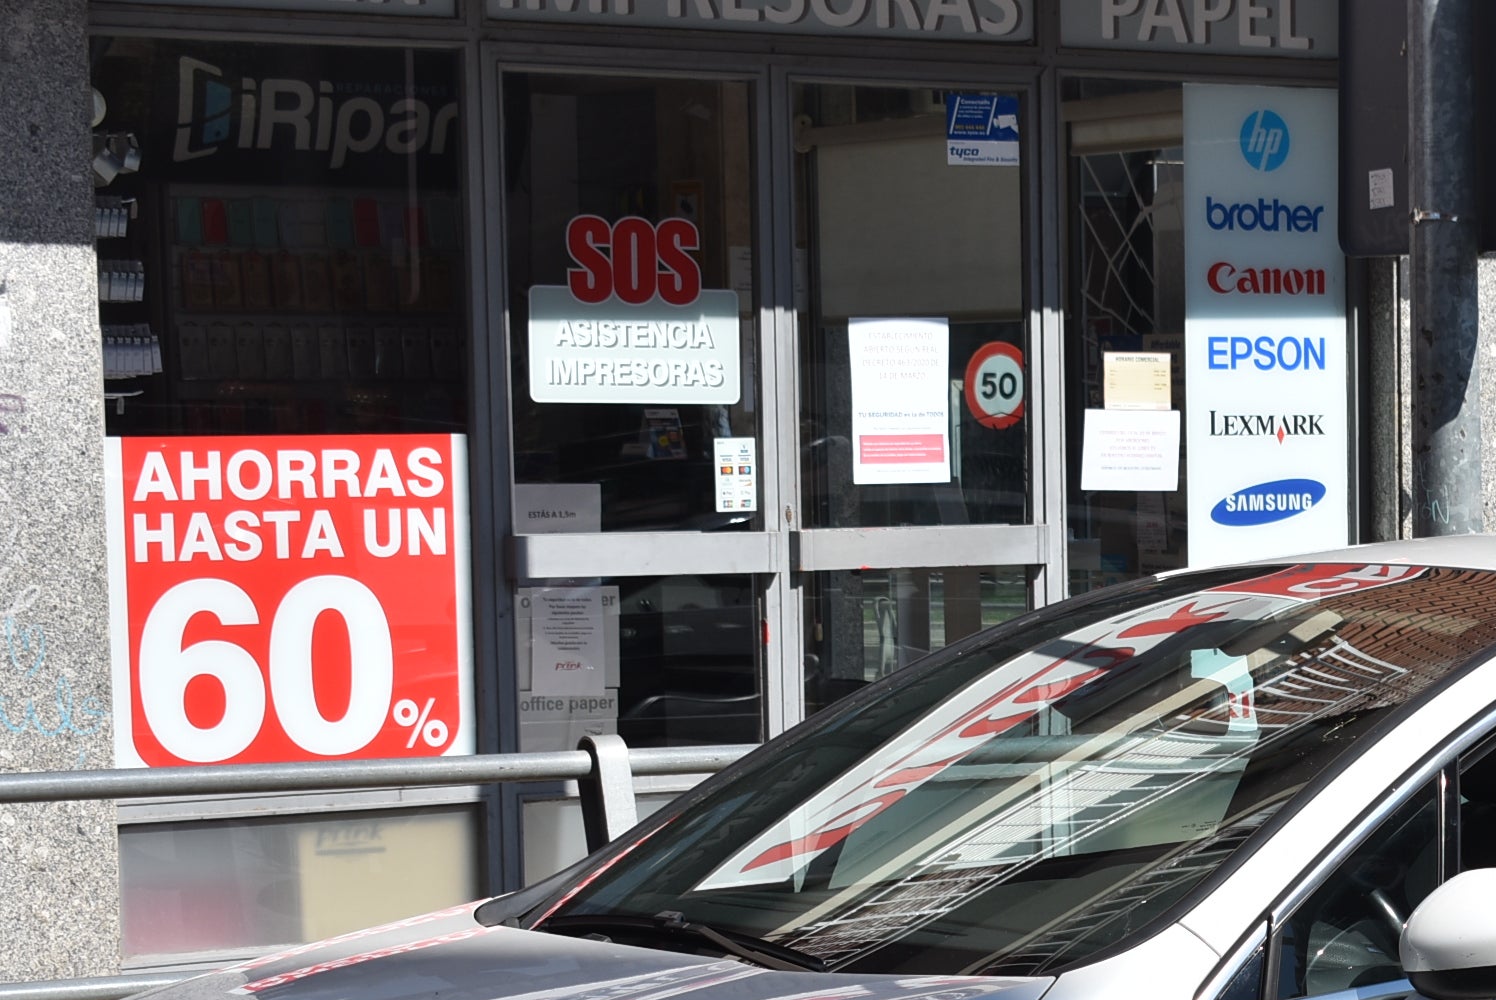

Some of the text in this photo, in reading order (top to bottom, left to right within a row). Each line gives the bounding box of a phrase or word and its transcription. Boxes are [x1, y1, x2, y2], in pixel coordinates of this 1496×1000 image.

[1101, 0, 1312, 49] PAPEL
[949, 146, 979, 158] tyco
[1247, 110, 1283, 171] hp
[1205, 196, 1324, 233] brother
[566, 215, 702, 306] SOS
[1207, 261, 1326, 295] Canon
[555, 319, 716, 350] ASISTENCIA
[1208, 336, 1325, 371] EPSON
[546, 357, 725, 388] IMPRESORAS
[981, 372, 1018, 400] 50
[1209, 410, 1325, 440] LEXMARK
[132, 446, 445, 502] AHORRAS
[1225, 493, 1313, 512] SAMSUNG
[132, 507, 448, 563] HASTA UN
[521, 696, 615, 714] office paper
